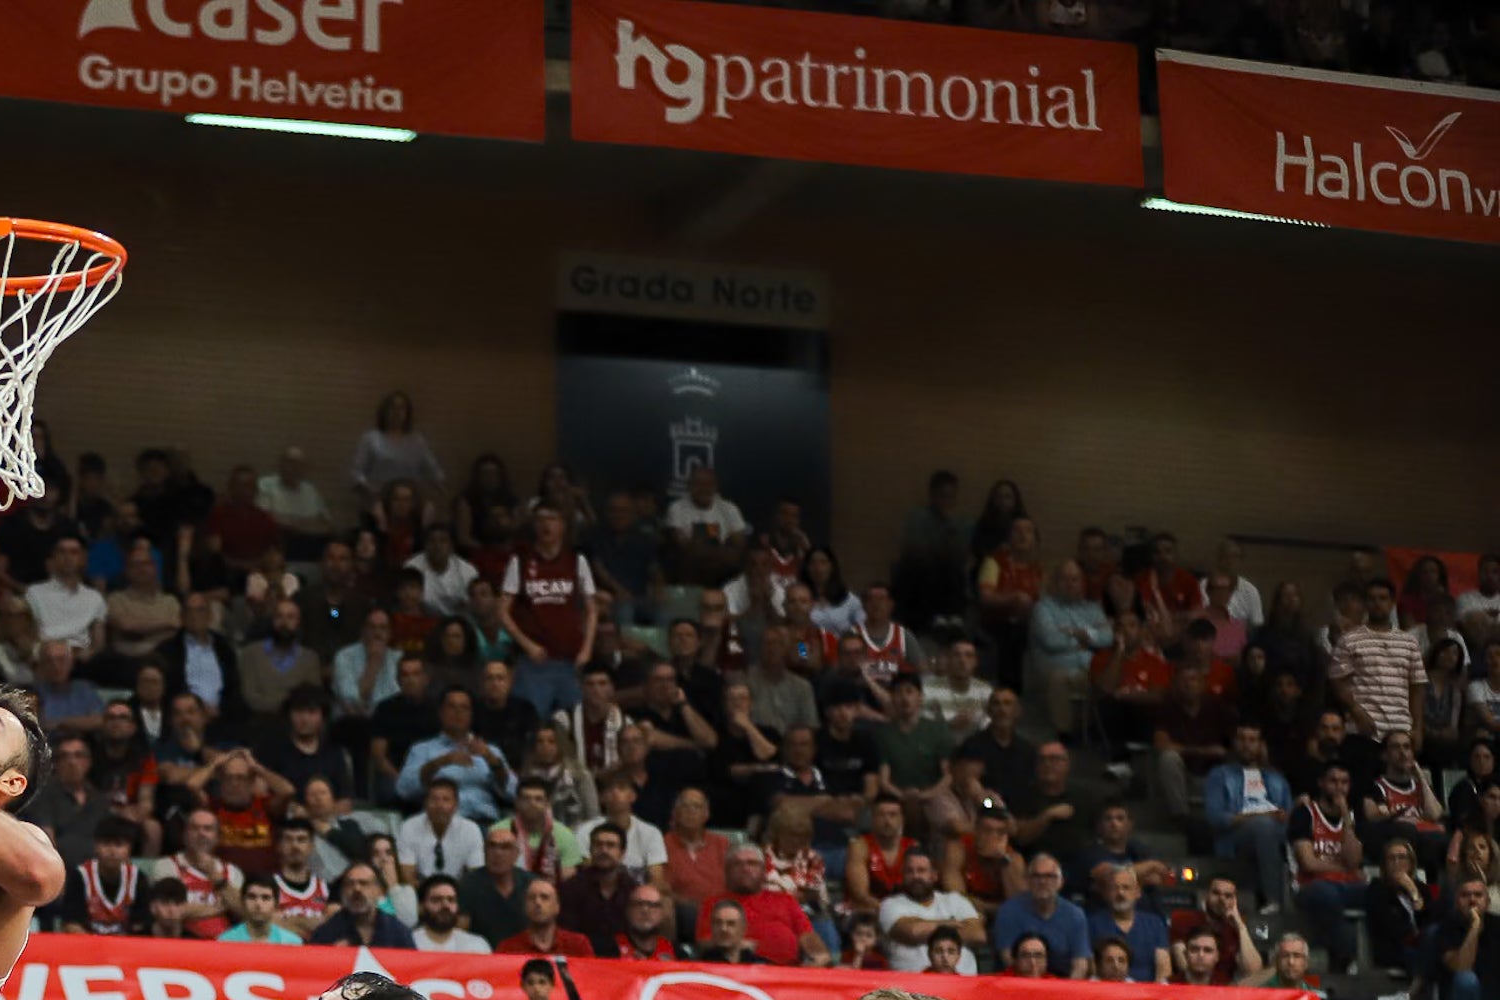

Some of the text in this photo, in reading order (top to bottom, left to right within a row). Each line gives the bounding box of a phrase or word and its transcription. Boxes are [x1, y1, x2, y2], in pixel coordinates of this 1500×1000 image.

[78, 53, 403, 112] Grupo Helvetia
[710, 47, 1102, 132] patrimonial
[570, 265, 818, 316] Grada Norte
